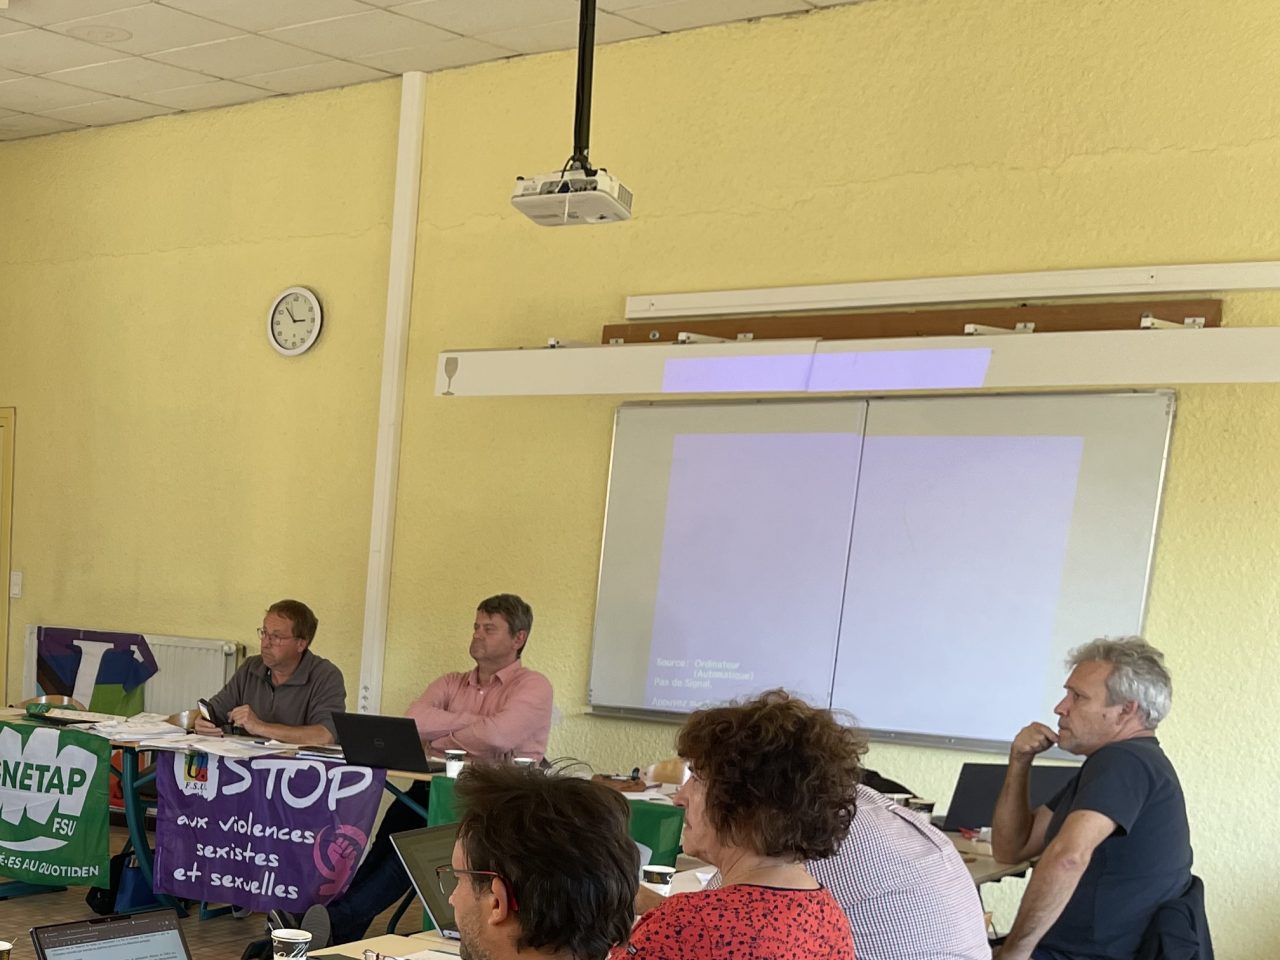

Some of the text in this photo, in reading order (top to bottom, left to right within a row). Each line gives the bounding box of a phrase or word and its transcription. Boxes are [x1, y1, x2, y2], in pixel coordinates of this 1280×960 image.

[672, 678, 682, 688] de
[222, 756, 373, 811] STOP
[52, 817, 77, 837] FSU
[176, 811, 315, 845] aux violences
[22, 858, 39, 872] AU
[195, 841, 280, 868] sexistes
[173, 861, 300, 900] et sexuelles
